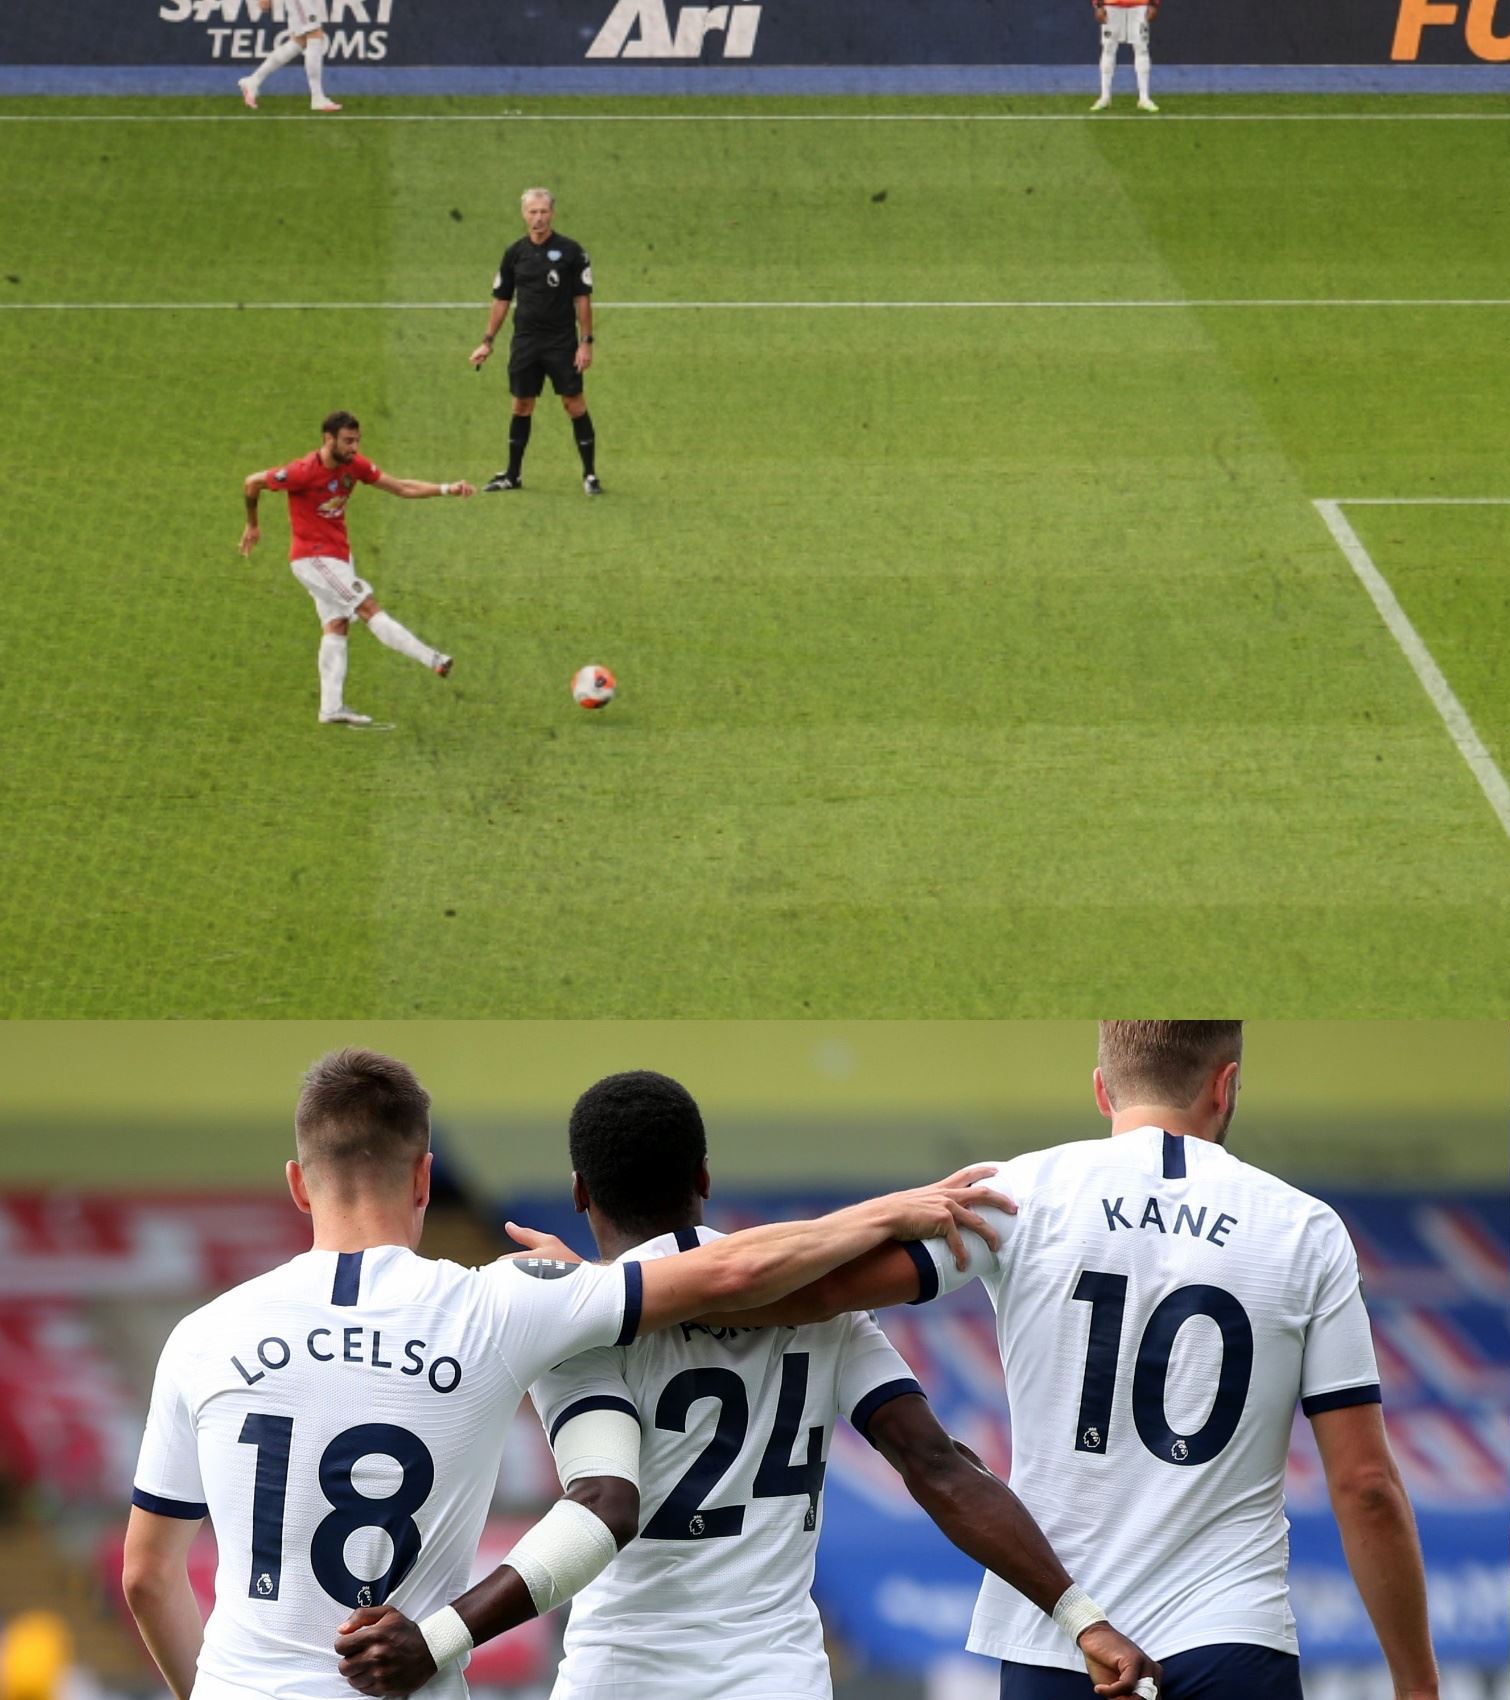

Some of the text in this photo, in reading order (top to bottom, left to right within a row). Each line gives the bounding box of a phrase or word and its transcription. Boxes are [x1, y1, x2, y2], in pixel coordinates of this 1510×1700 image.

[584, 0, 763, 58] Ari
[1101, 1196, 1239, 1248] KANE
[230, 1326, 463, 1395] LO CELSO
[1072, 1270, 1255, 1466] 10
[237, 1412, 435, 1609] 18
[640, 1352, 827, 1541] 24
